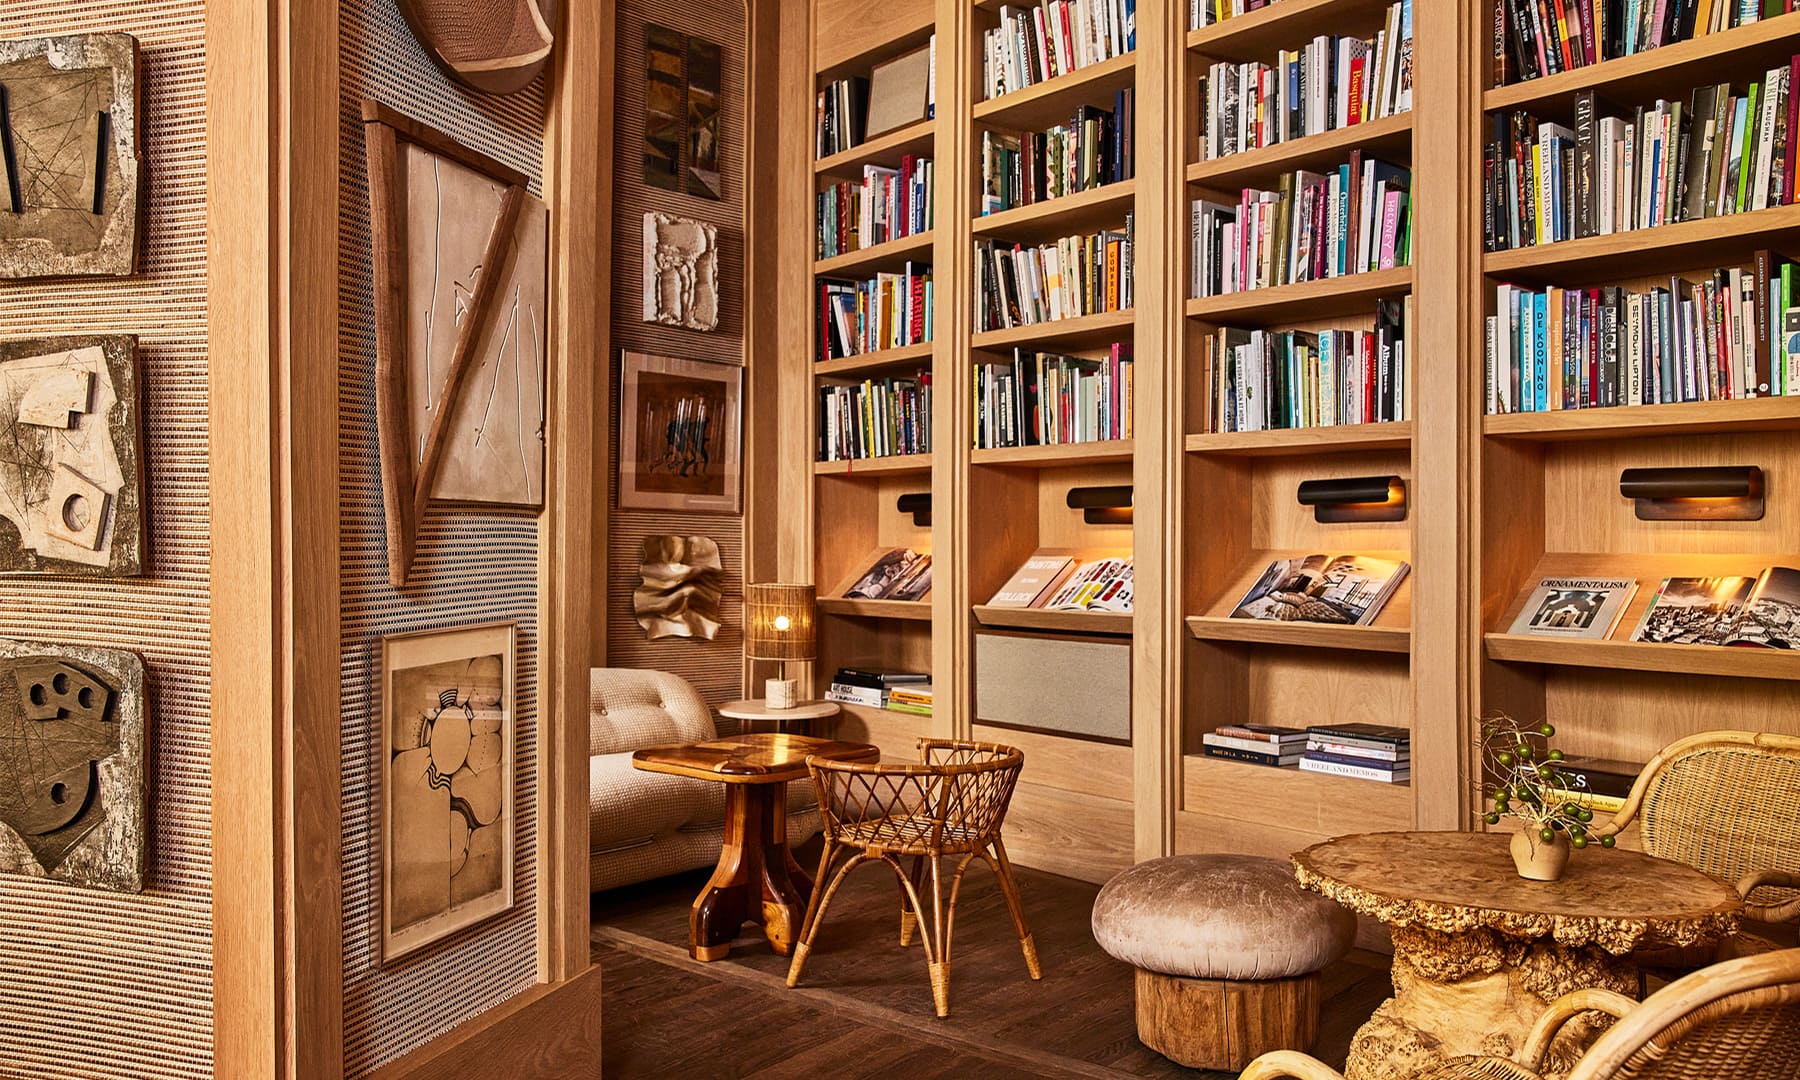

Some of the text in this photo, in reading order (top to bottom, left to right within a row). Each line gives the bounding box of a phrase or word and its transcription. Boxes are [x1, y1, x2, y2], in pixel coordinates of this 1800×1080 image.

[1348, 69, 1362, 116] Basquiat
[1763, 75, 1779, 143] SYRIE MAUGHAM
[1526, 180, 1534, 222] NOSTALGIA
[1542, 132, 1551, 228] VREELAND MEMOS
[1338, 191, 1347, 241] Outerbridge
[1384, 200, 1396, 249] HOCKNEY
[1537, 312, 1543, 328] DE
[1605, 306, 1616, 362] Dress Code
[1382, 345, 1390, 375] Album
[1540, 580, 1630, 590] ORNAMENTALISM
[1304, 762, 1379, 778] VREELAND MEMOS
